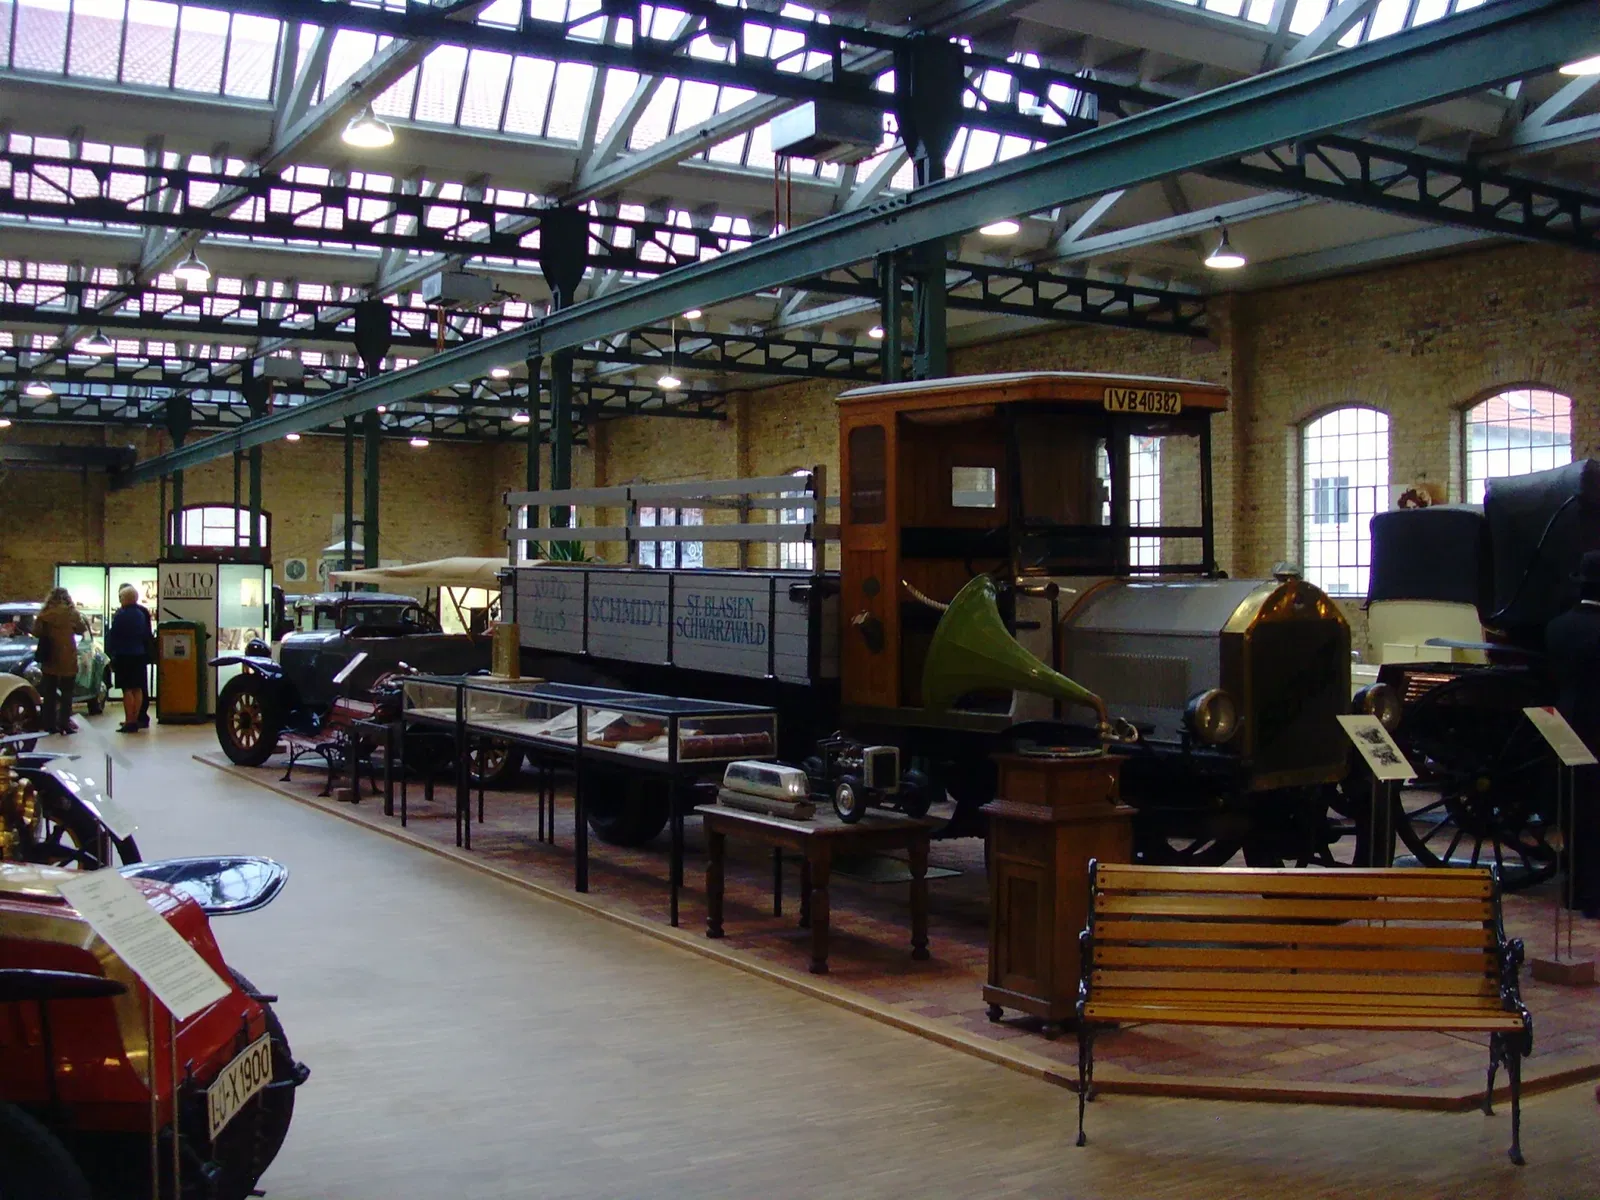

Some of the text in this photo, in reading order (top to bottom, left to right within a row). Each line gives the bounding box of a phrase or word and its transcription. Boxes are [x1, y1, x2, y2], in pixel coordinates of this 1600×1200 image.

[164, 572, 213, 588] AUTO
[591, 595, 667, 628] SCHMIDT
[687, 594, 755, 620] ST. BLASIEN
[676, 616, 767, 646] SCHWARZWALD
